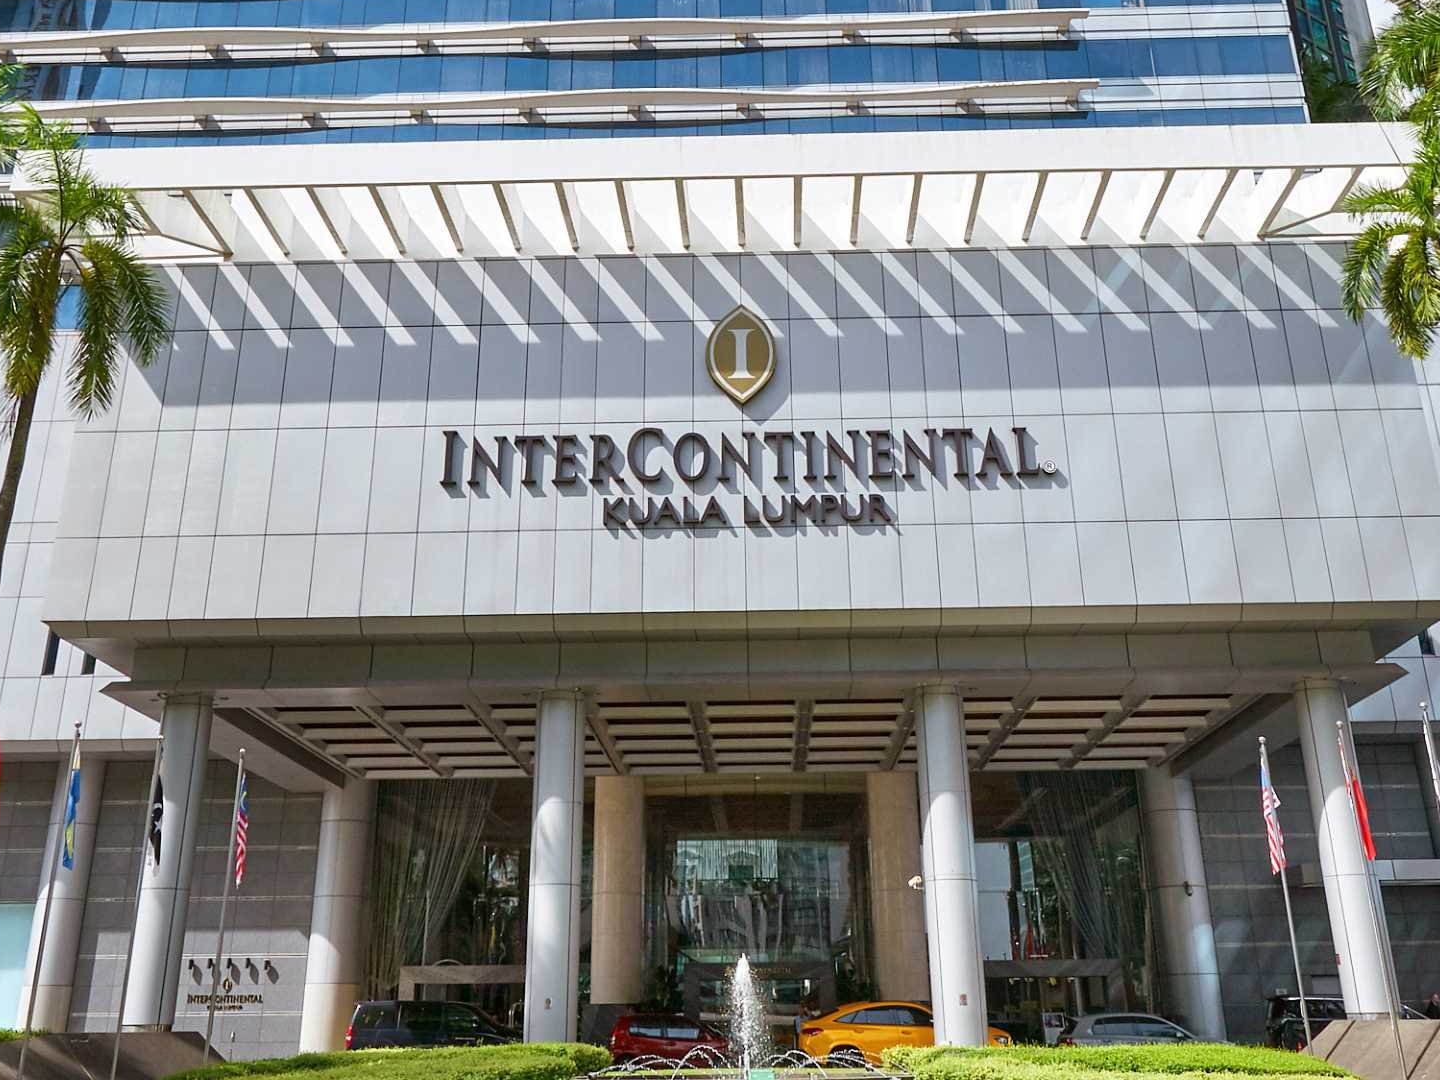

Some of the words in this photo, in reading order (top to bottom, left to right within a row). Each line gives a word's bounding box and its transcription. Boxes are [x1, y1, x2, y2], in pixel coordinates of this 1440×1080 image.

[602, 495, 728, 525] KUALA
[744, 493, 893, 525] LUMPUR
[187, 993, 263, 1004] INTERONTINENTAL
